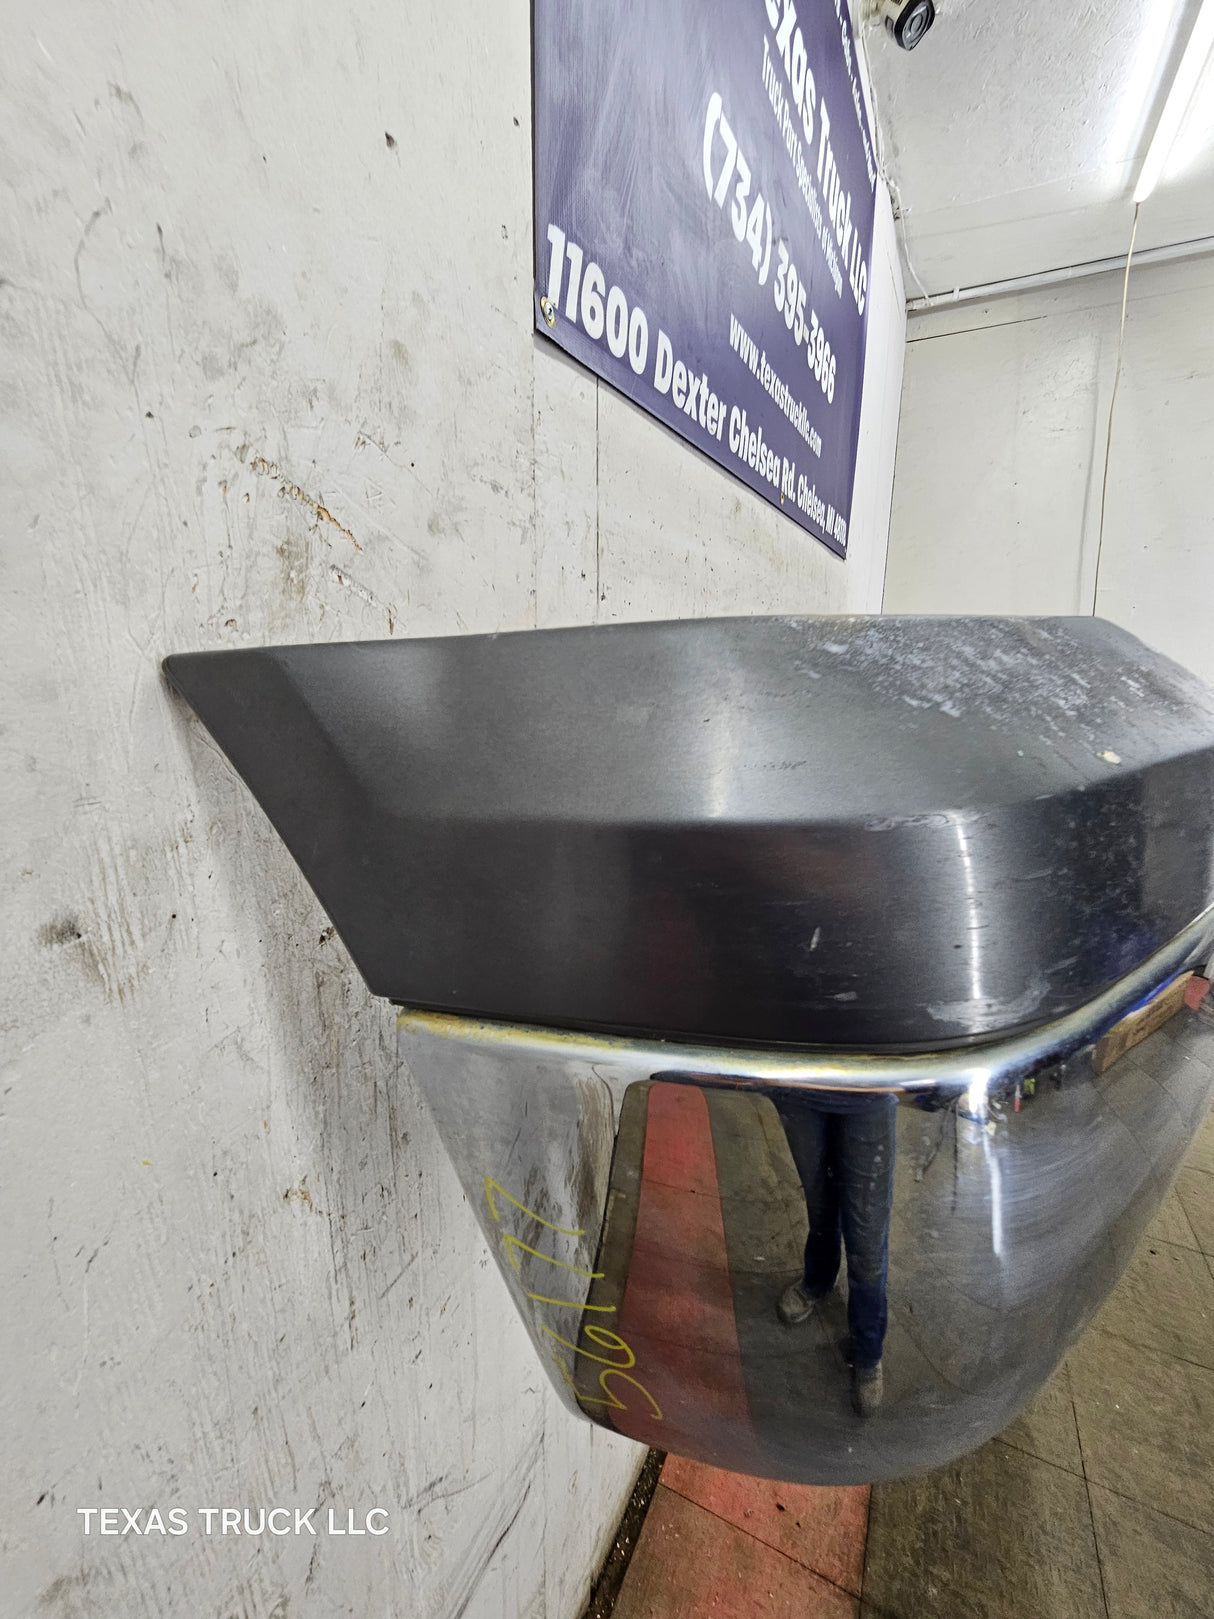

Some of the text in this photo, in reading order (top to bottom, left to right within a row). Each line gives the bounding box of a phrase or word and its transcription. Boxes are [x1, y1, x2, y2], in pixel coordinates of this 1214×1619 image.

[762, 34, 784, 129] Truck
[817, 96, 852, 271] Truck
[849, 226, 868, 316] LLC
[547, 223, 649, 375] 11600
[653, 328, 727, 441] Dexter
[729, 405, 781, 488] Chelsea
[782, 456, 796, 503] Rd.
[797, 474, 826, 534] Chelsea,
[703, 92, 837, 404] (734) 395-3966
